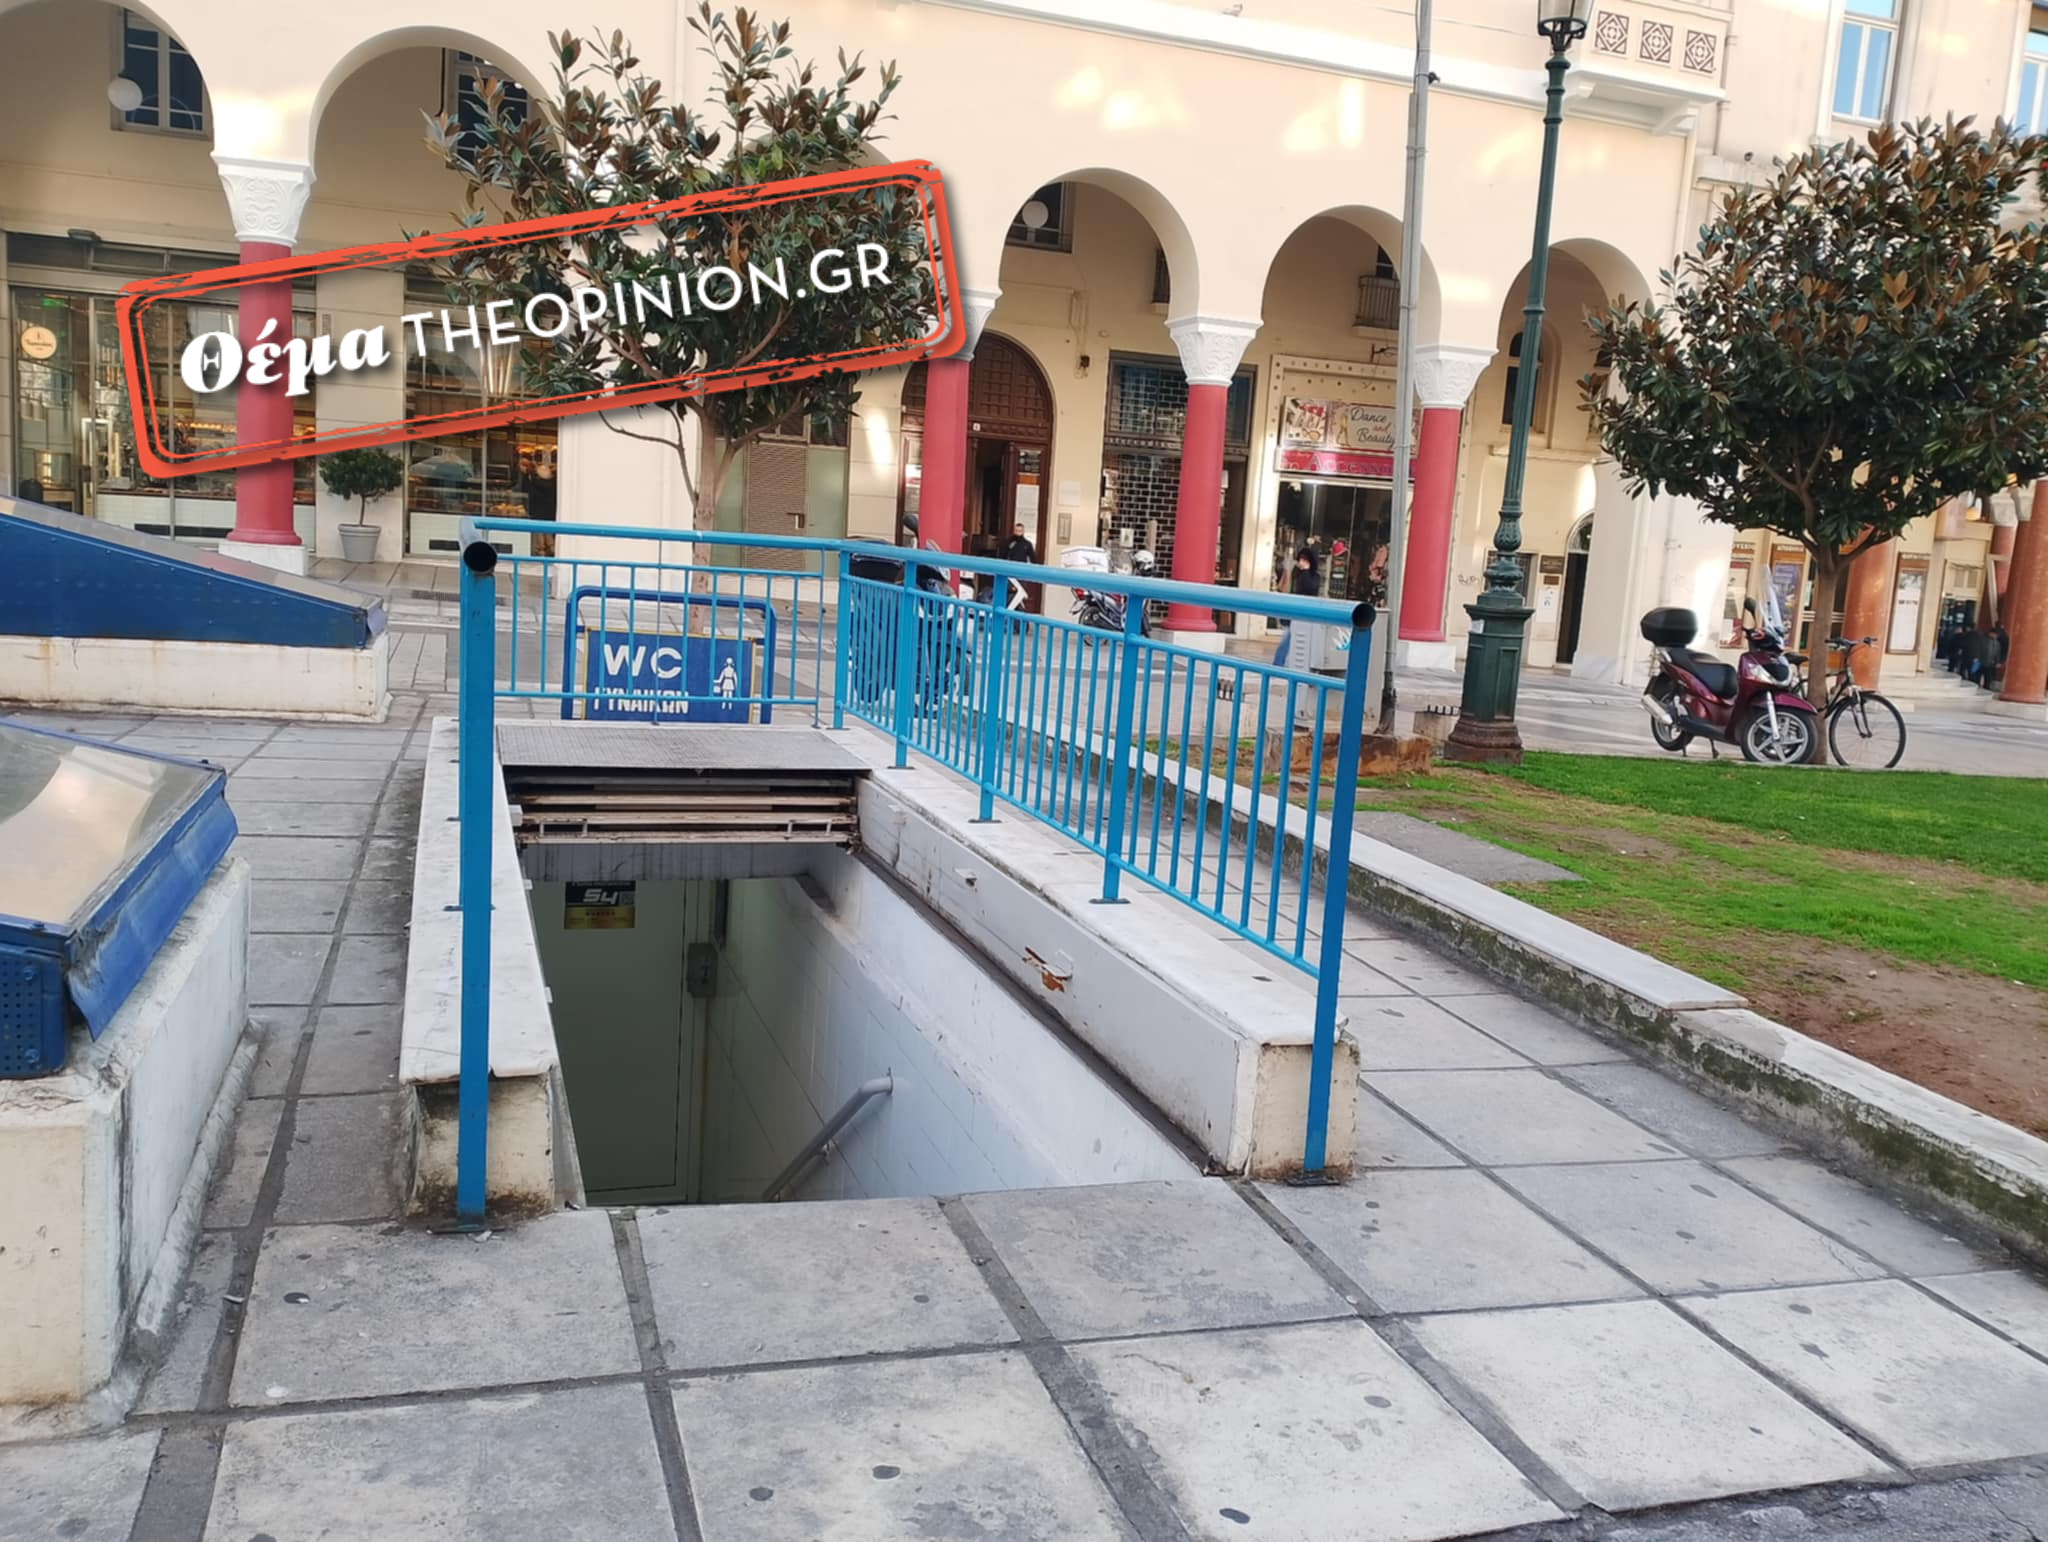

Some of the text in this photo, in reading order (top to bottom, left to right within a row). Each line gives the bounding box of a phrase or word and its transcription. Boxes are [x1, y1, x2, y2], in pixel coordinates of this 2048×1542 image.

[1350, 406, 1388, 422] Dance
[1357, 428, 1395, 449] Beauty
[603, 644, 682, 679] WC
